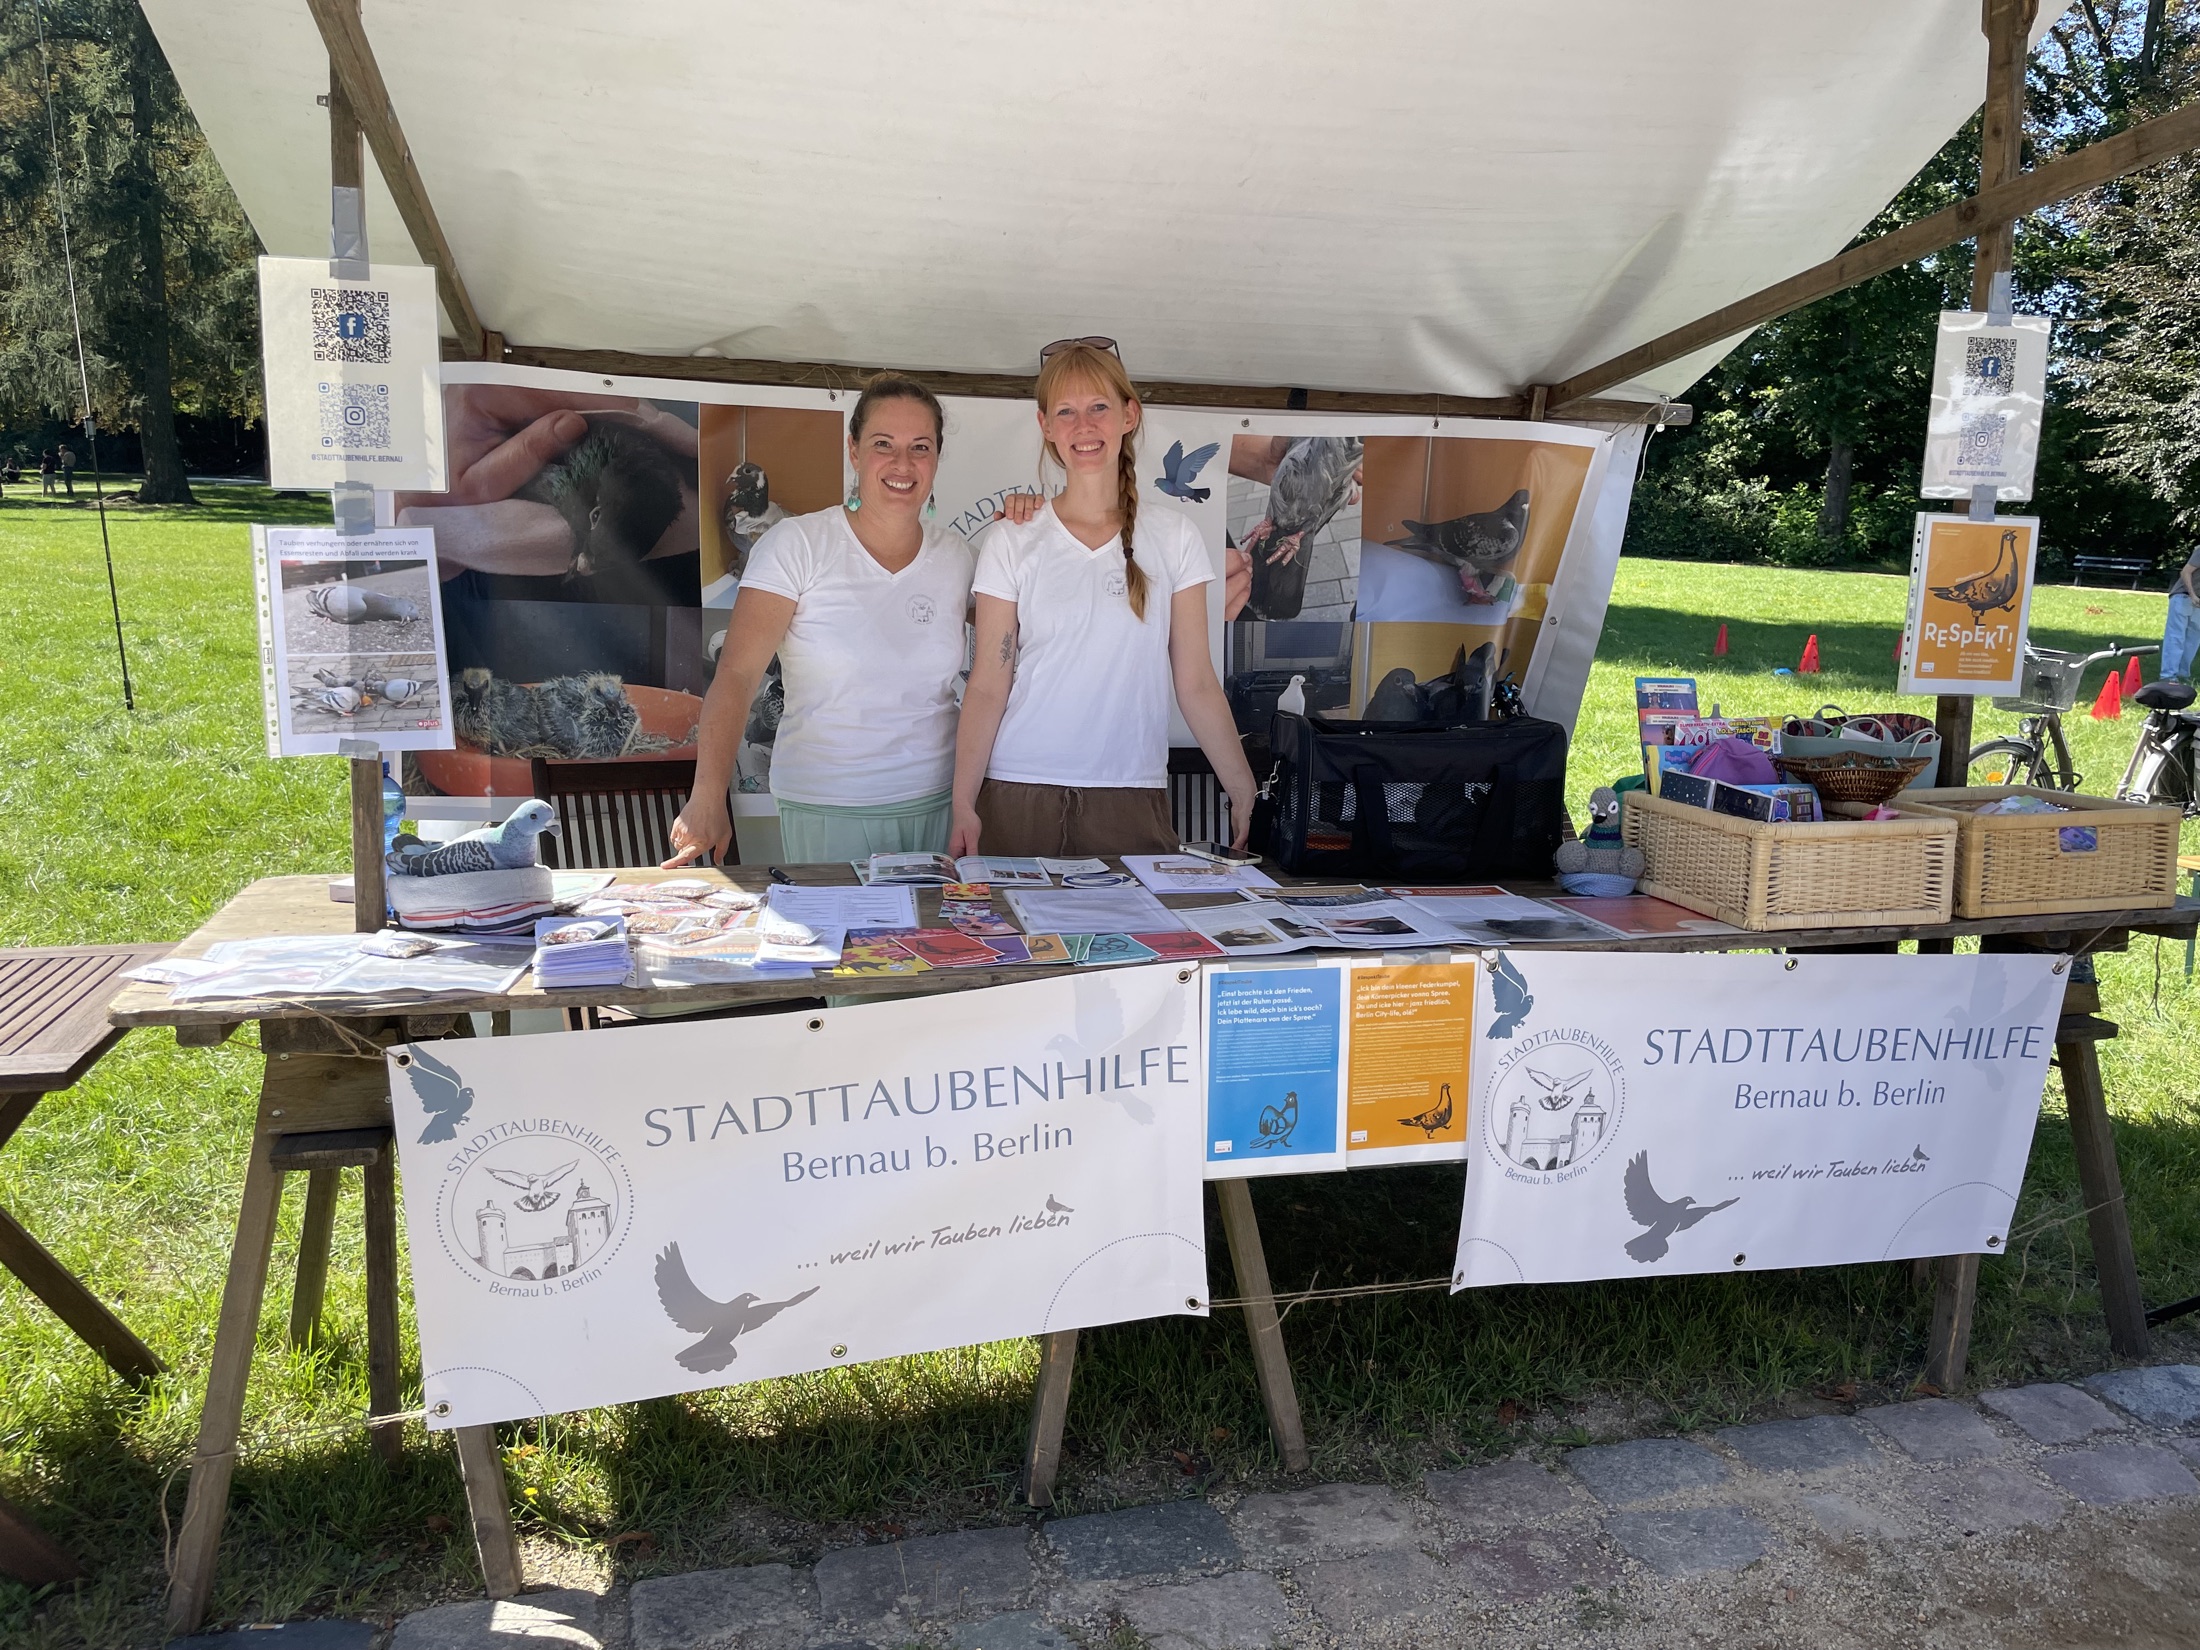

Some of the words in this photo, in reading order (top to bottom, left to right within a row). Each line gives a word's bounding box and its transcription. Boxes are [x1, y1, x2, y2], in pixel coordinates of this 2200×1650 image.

[312, 454, 403, 462] @STADTTAUBENHILFE.BERNAU
[948, 484, 1067, 536] TADTTAU
[1924, 622, 2012, 652] RESPEKT!
[423, 719, 439, 727] plus
[1371, 992, 1410, 1001] Körnerpicker
[1420, 980, 1460, 989] Federkumpel,
[1272, 997, 1293, 1005] passé.
[1375, 1010, 1401, 1018] City-life,
[1498, 1028, 1625, 1076] STADTTAUBENHILFE
[1643, 1025, 2044, 1066] STADTTAUBENHILFE
[644, 1044, 1190, 1148] STADTTAUBENHILFE
[1734, 1083, 1828, 1109] Bernau
[1838, 1079, 1861, 1106] b.
[1873, 1078, 1946, 1106] Berlin
[447, 1118, 622, 1175] STADTTAUBENHILFE
[783, 1148, 910, 1183] Bernau
[925, 1135, 958, 1168] b.
[974, 1123, 1072, 1162] Berlin
[1504, 1167, 1540, 1185] Bernau
[1543, 1172, 1553, 1185] b.
[1556, 1165, 1588, 1182] Berlin
[1752, 1164, 1792, 1180] weil
[1793, 1164, 1824, 1179] wir
[1826, 1160, 1876, 1178] Tauben
[1881, 1158, 1926, 1174] lieben
[830, 1240, 880, 1265] weil
[884, 1235, 926, 1256] wir
[930, 1222, 1002, 1249] Tauben
[1008, 1210, 1070, 1234] lieben
[488, 1281, 539, 1297] Bernau
[544, 1284, 558, 1296] b.
[561, 1268, 603, 1292] Berlin
